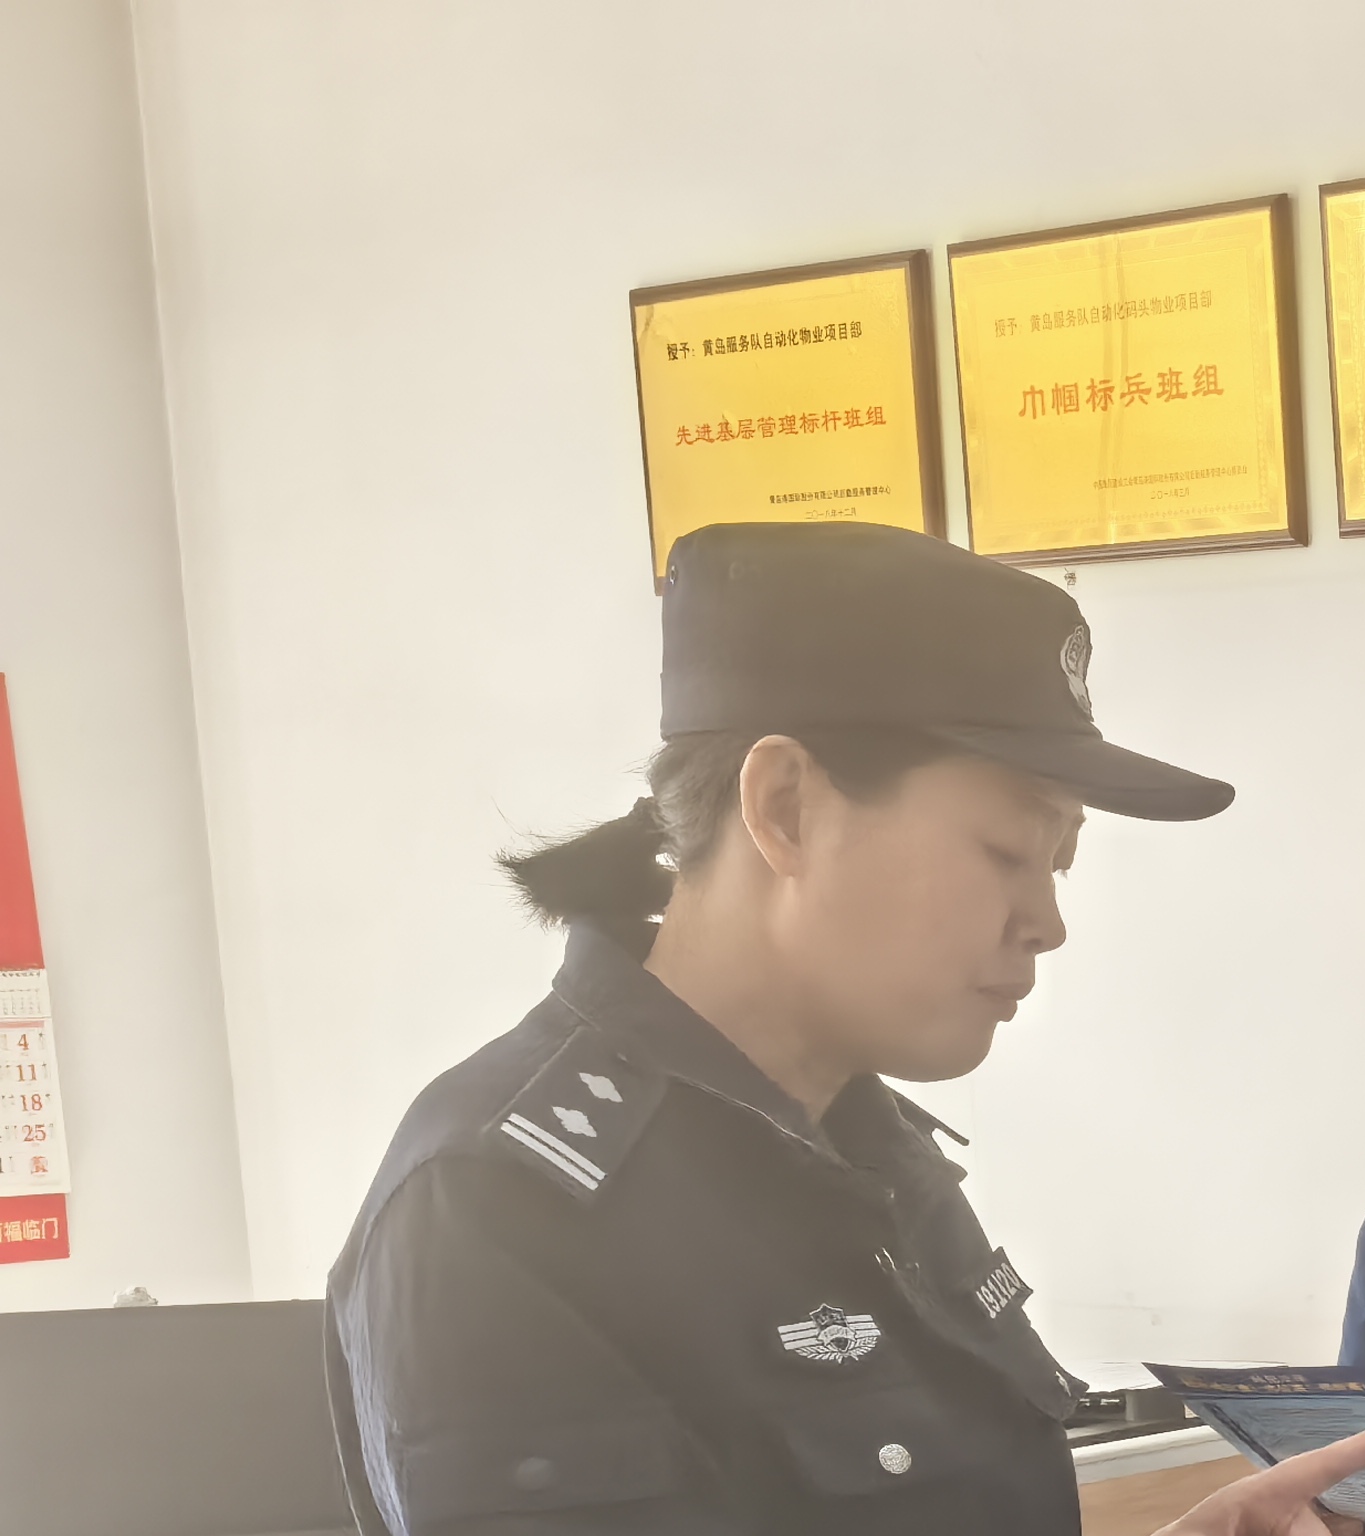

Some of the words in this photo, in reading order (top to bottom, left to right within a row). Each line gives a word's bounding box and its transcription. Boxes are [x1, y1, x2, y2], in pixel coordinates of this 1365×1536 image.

[1018, 363, 1224, 420] 巾帼标兵班组
[675, 405, 887, 447] 先进基层管理标杆班组
[20, 1093, 43, 1112] 18
[0, 1217, 59, 1243] 福临门
